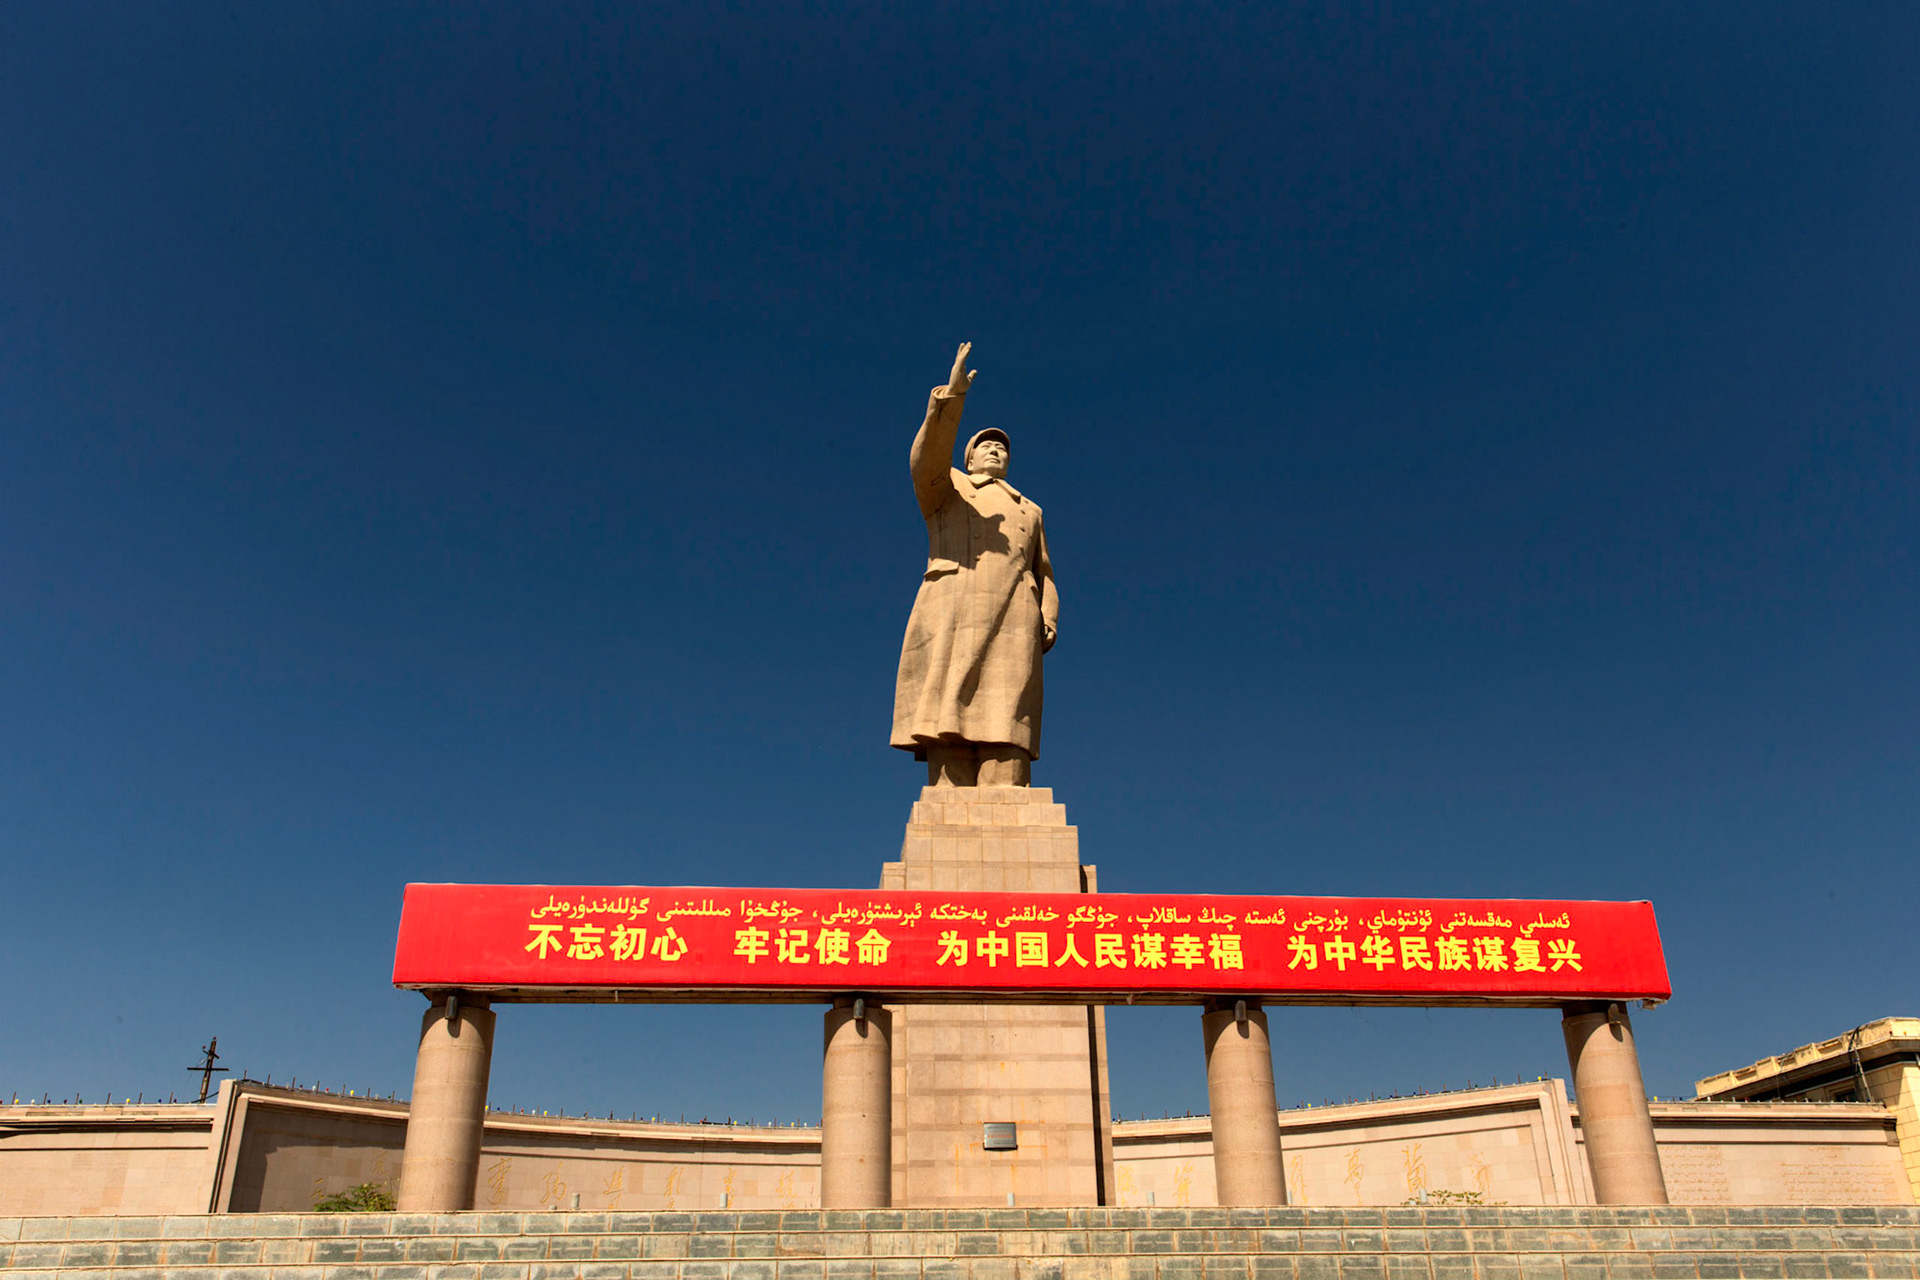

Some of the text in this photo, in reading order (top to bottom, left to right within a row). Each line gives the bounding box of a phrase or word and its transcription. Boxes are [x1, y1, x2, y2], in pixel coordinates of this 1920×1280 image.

[1244, 908, 1286, 925] ئەستە
[1440, 912, 1513, 933] مەقسەتنى
[524, 923, 1583, 973] 不忘初心 牢记使命 为中国人民谋幸福 为中华民族谋复兴
